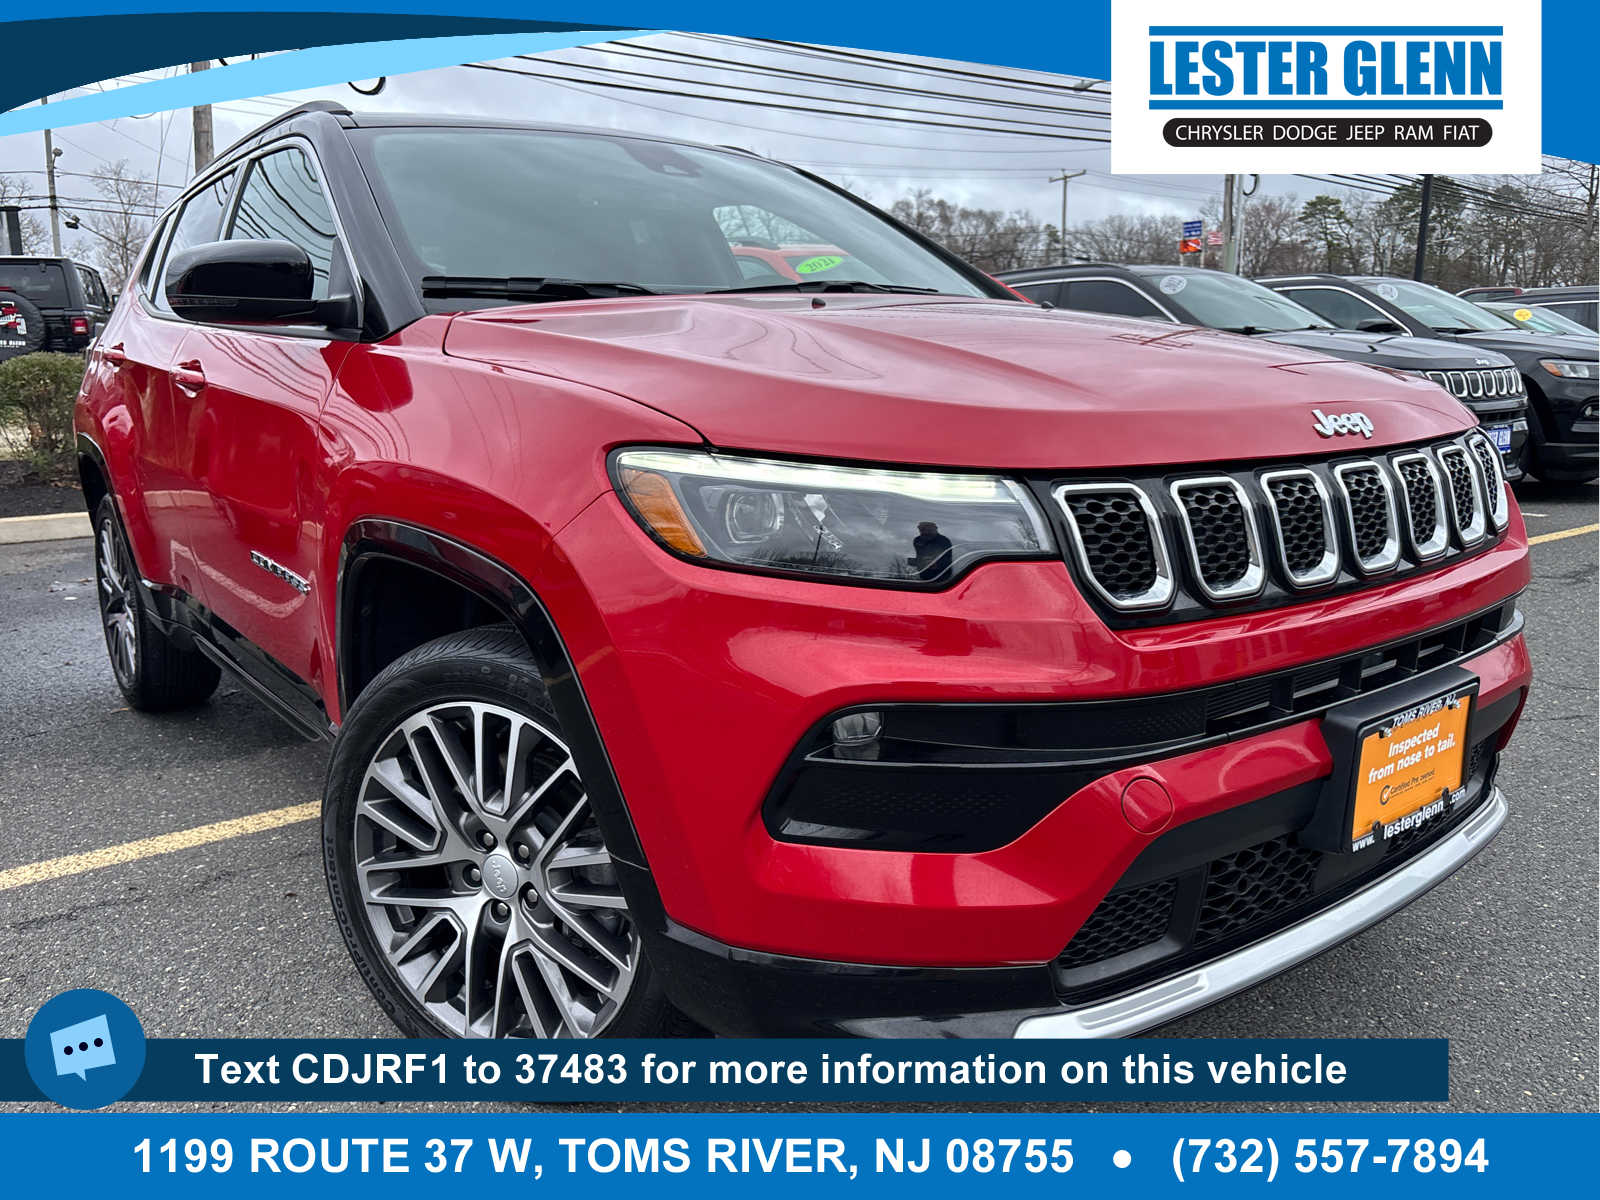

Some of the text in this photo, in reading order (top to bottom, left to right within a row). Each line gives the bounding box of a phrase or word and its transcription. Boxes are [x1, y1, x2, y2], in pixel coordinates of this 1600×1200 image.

[1311, 409, 1374, 439] Jeep
[1392, 709, 1417, 728] TOMS
[1388, 723, 1440, 758] Inspected
[1368, 733, 1456, 785] from nose to tail.
[1383, 801, 1444, 840] lesterglenn
